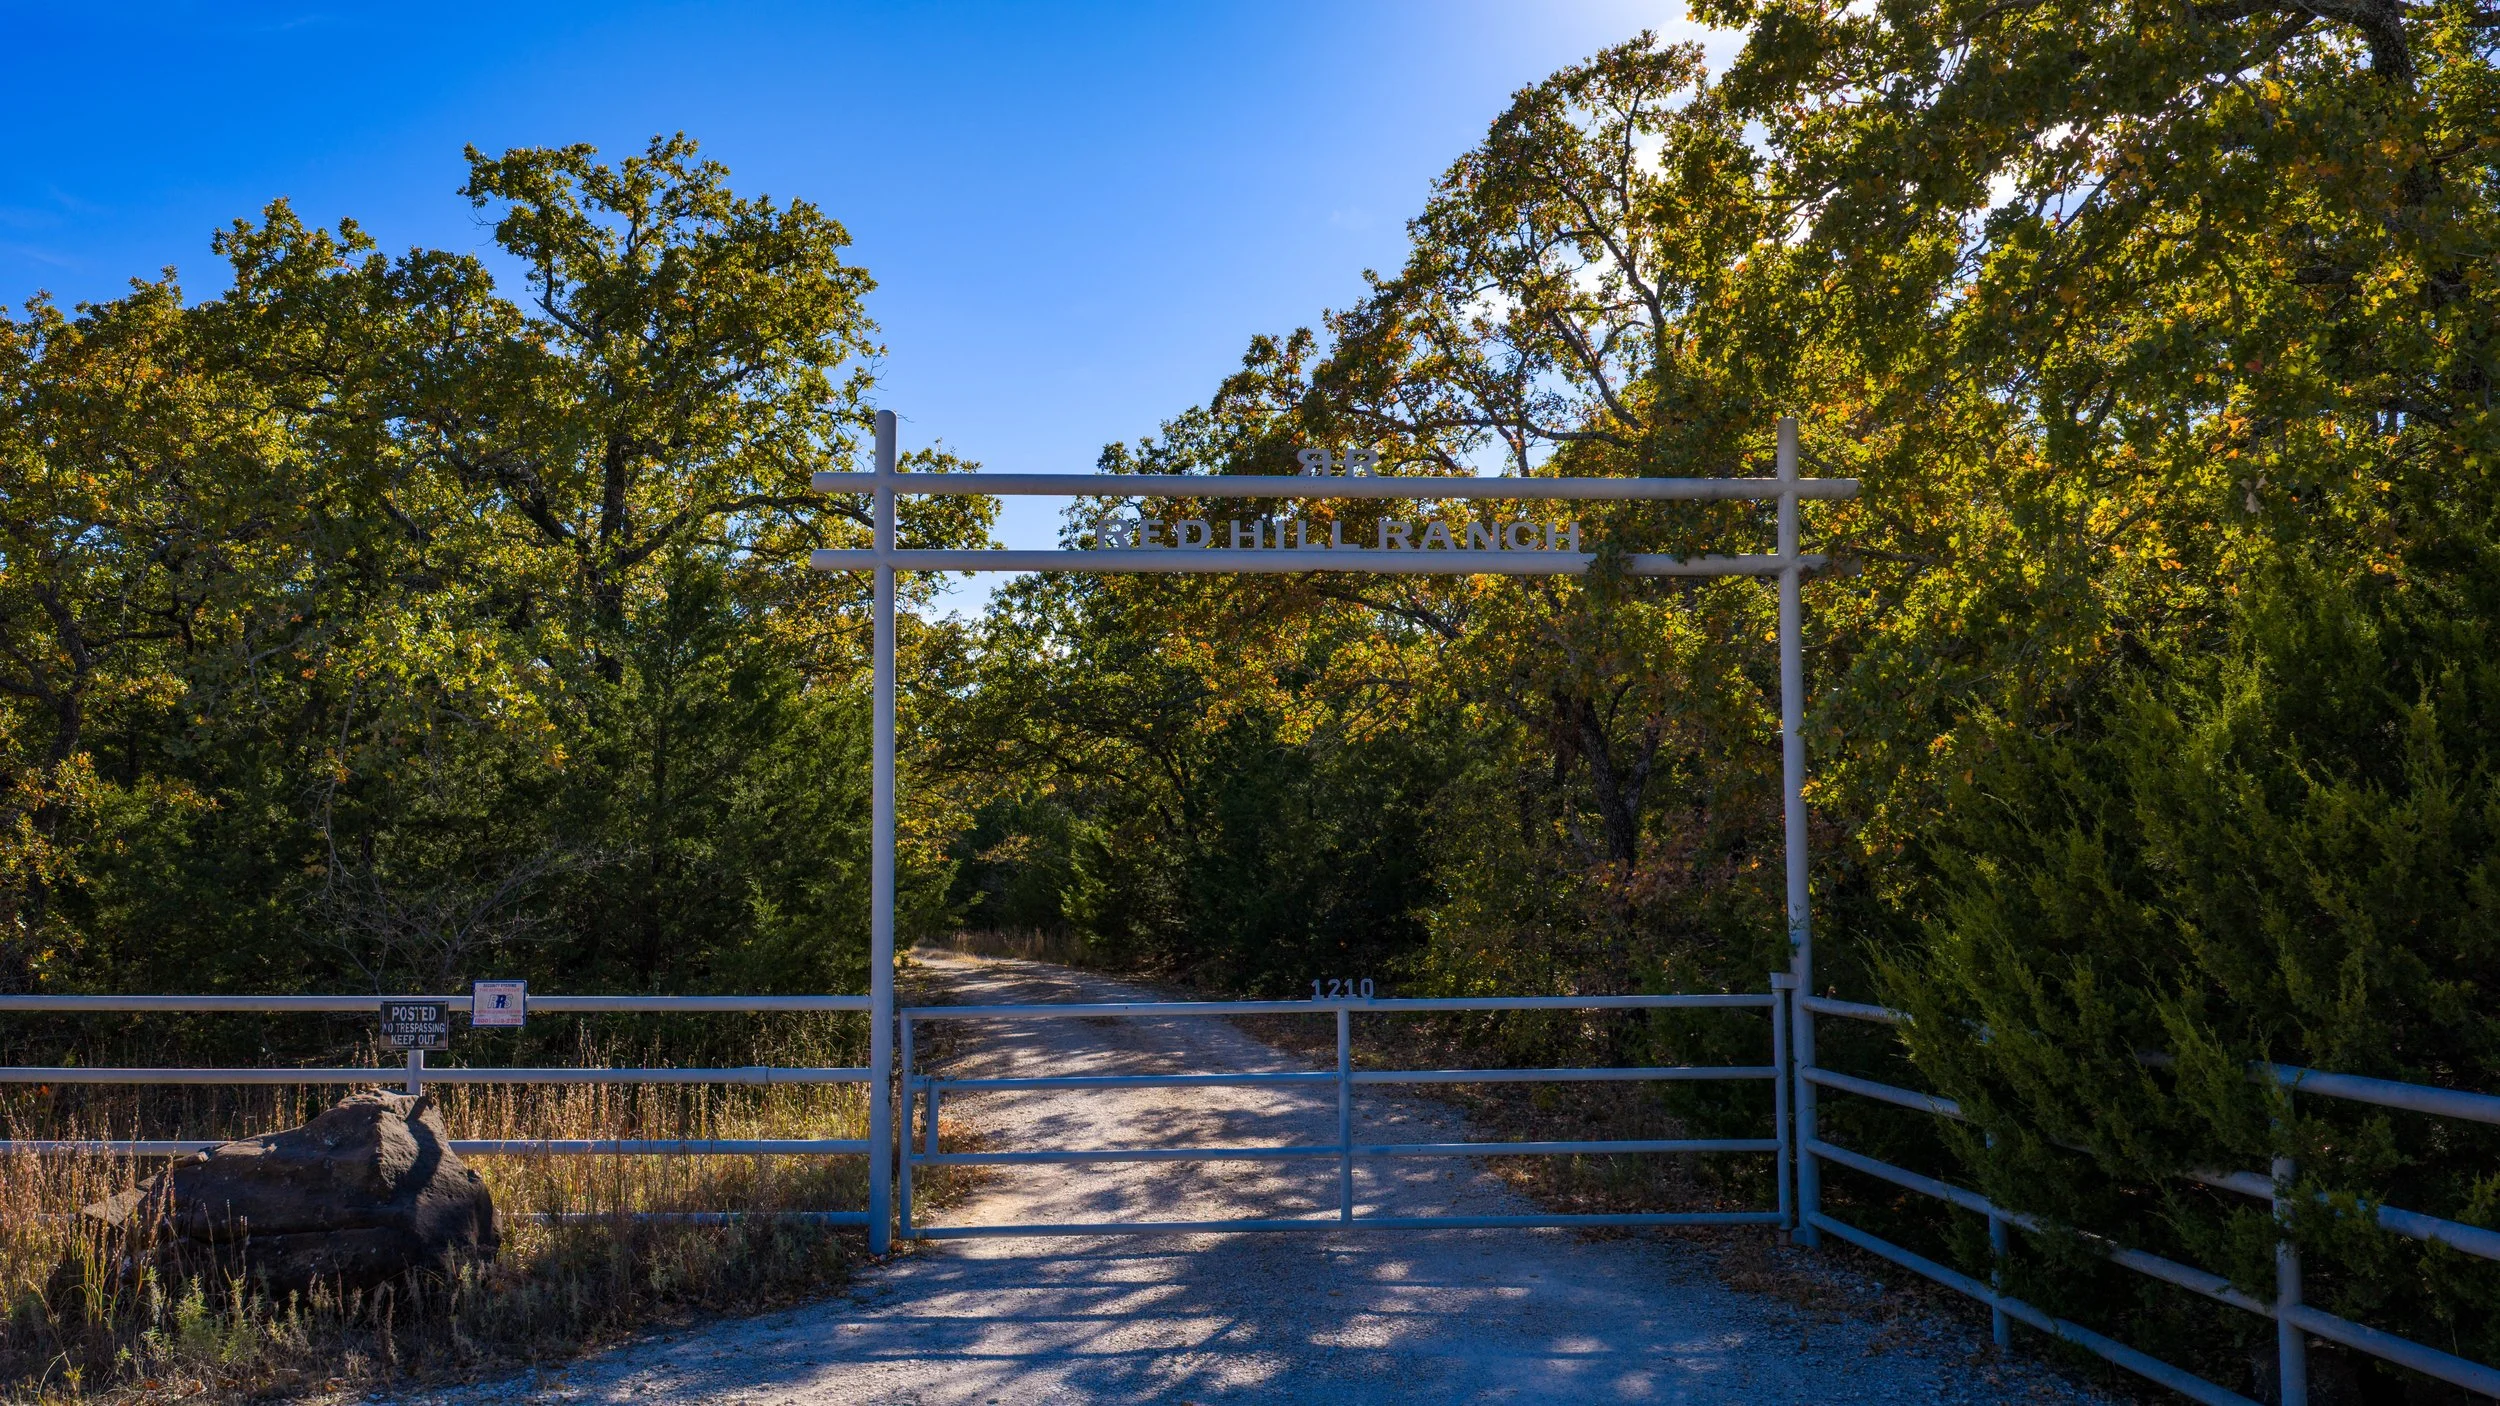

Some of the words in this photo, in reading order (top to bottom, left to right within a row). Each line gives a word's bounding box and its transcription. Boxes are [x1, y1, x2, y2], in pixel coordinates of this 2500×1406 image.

[1097, 519, 1212, 549] RED
[1230, 520, 1362, 550] HILL
[1378, 521, 1580, 552] RANCH
[1311, 978, 1374, 999] 1210
[392, 1006, 436, 1021] POSTED
[383, 1023, 393, 1032] NO
[396, 1022, 445, 1033] TRESPASSING
[391, 1034, 415, 1045] KEEP
[418, 1034, 436, 1045] OUT
